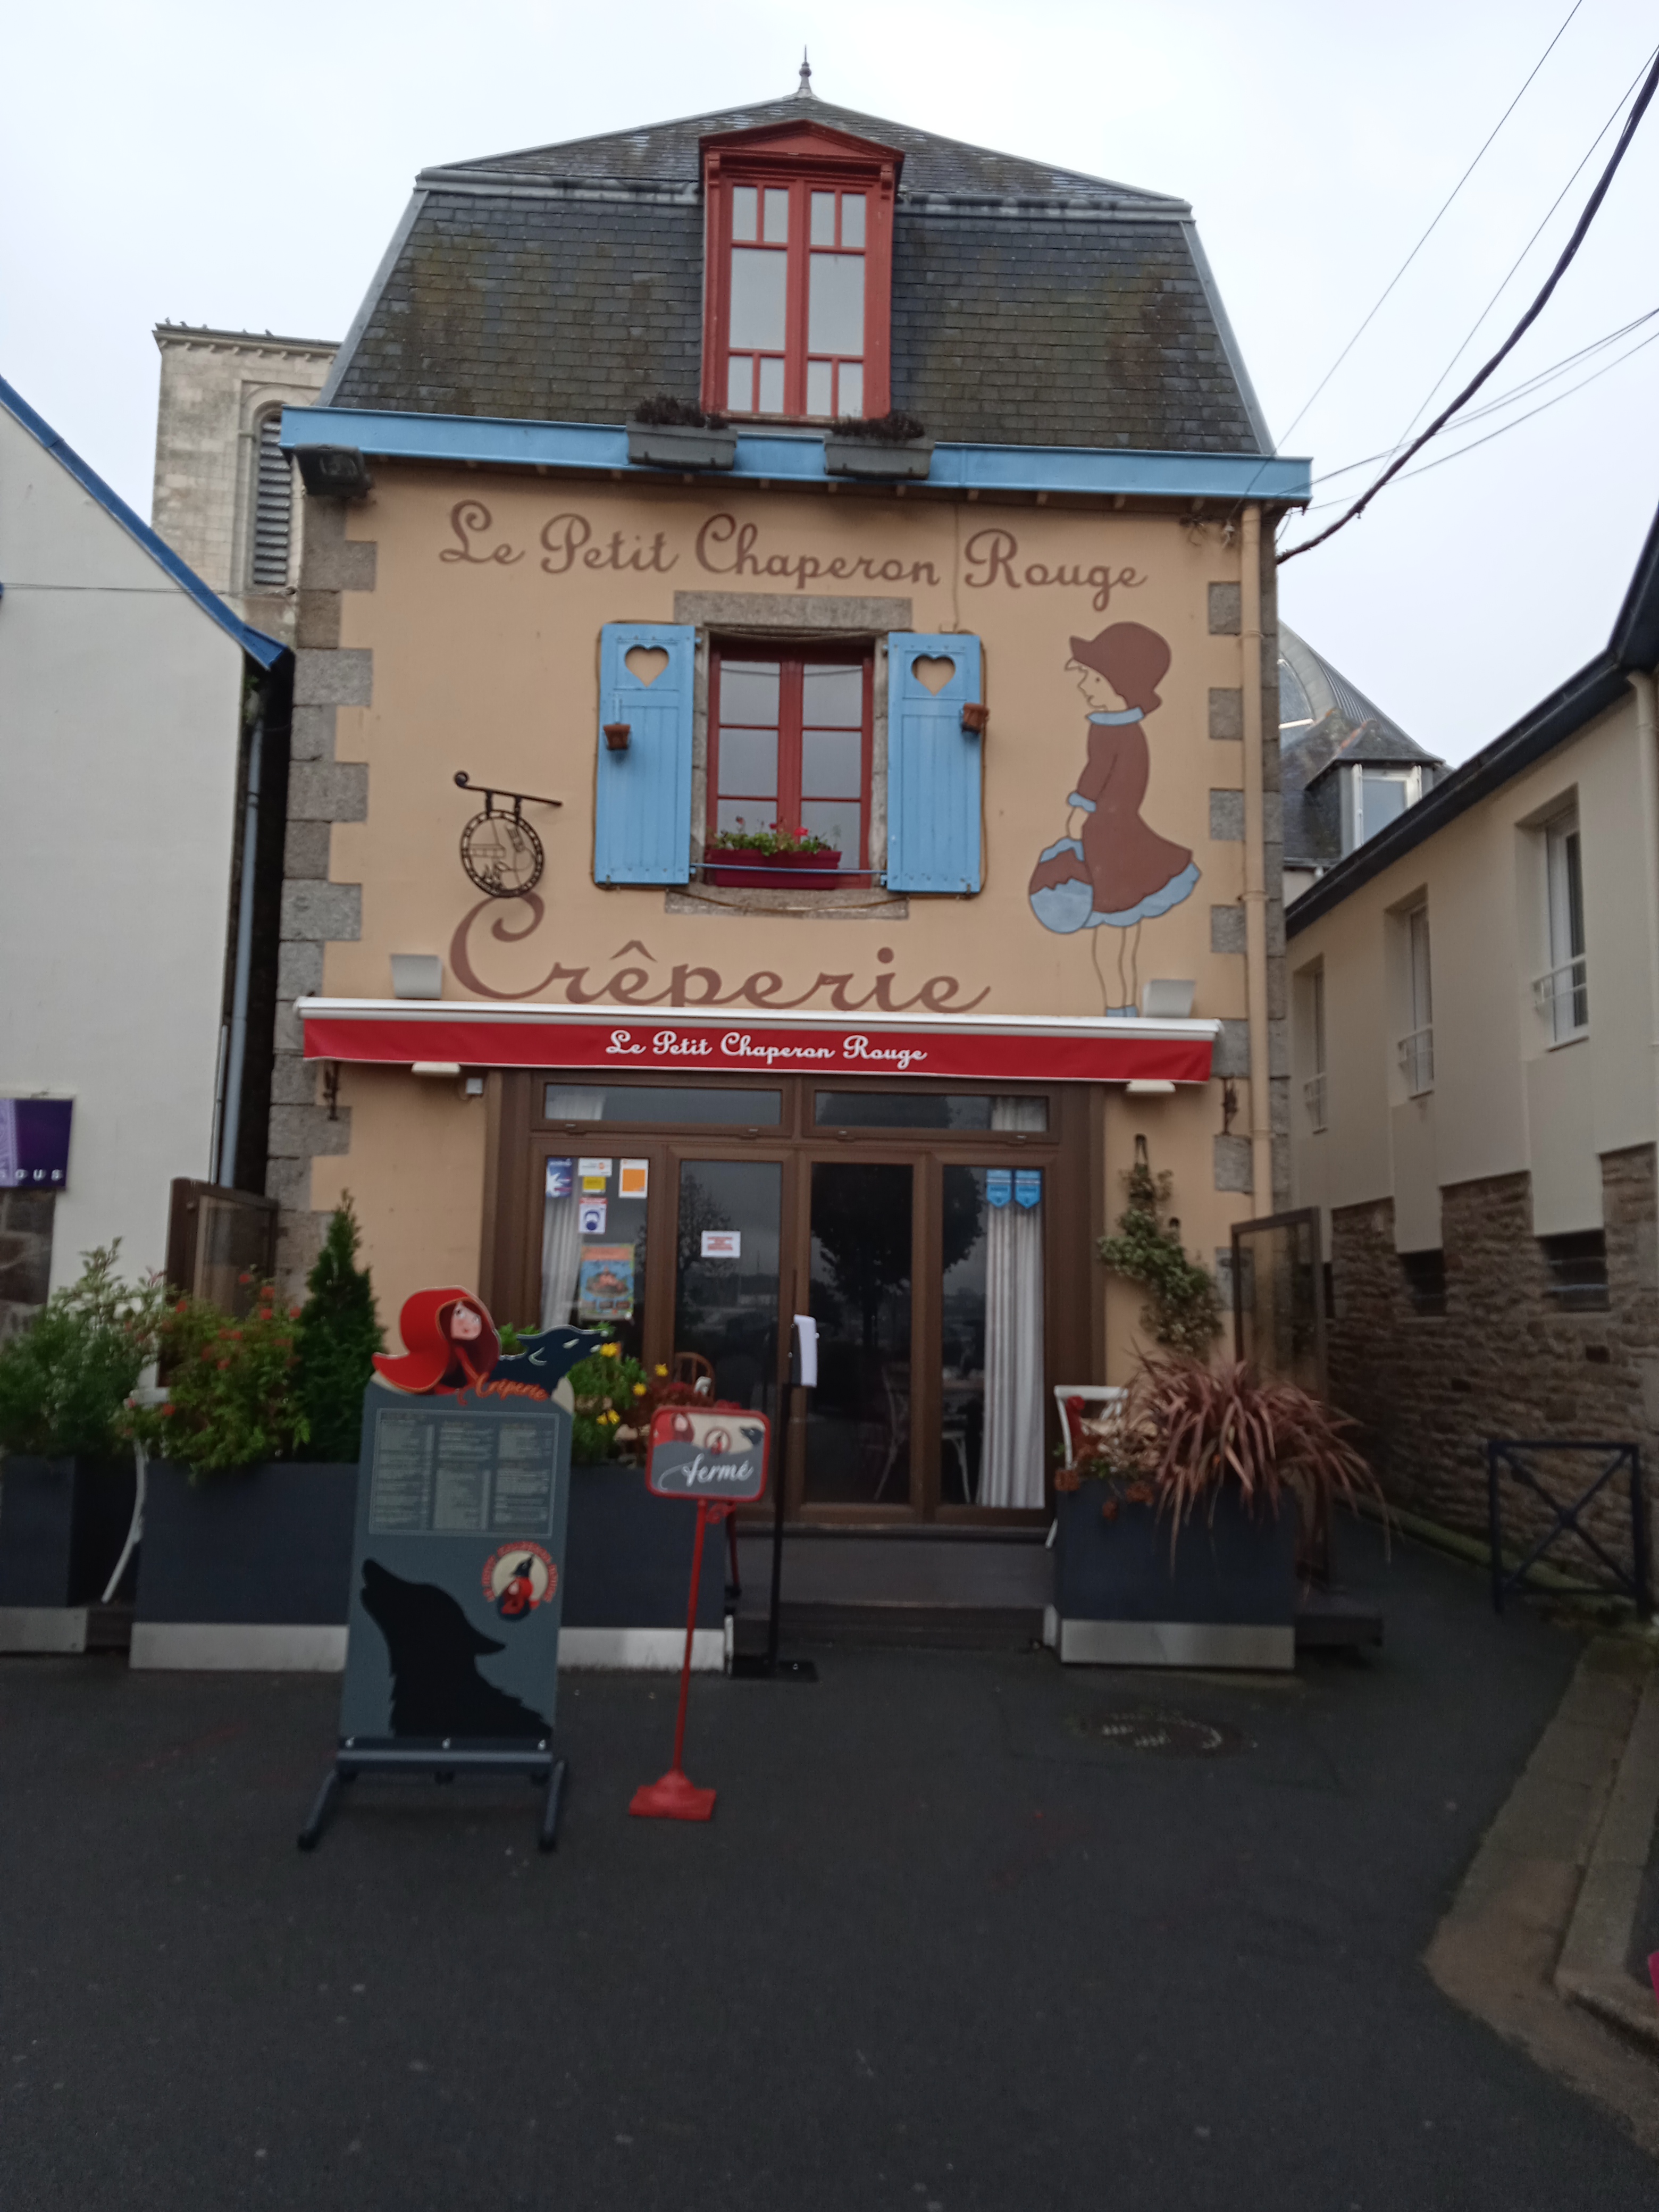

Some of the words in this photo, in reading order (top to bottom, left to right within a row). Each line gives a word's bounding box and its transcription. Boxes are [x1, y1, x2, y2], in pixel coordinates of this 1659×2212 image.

[439, 499, 525, 565] Le
[540, 513, 679, 574] Petit
[696, 513, 941, 590] Chaperon
[964, 528, 1147, 611] Rouge
[449, 889, 991, 1013] Crêperie
[606, 1030, 646, 1054] Le
[652, 1030, 713, 1055] Petit
[720, 1032, 835, 1064] Chaperon
[843, 1035, 928, 1069] Rouge
